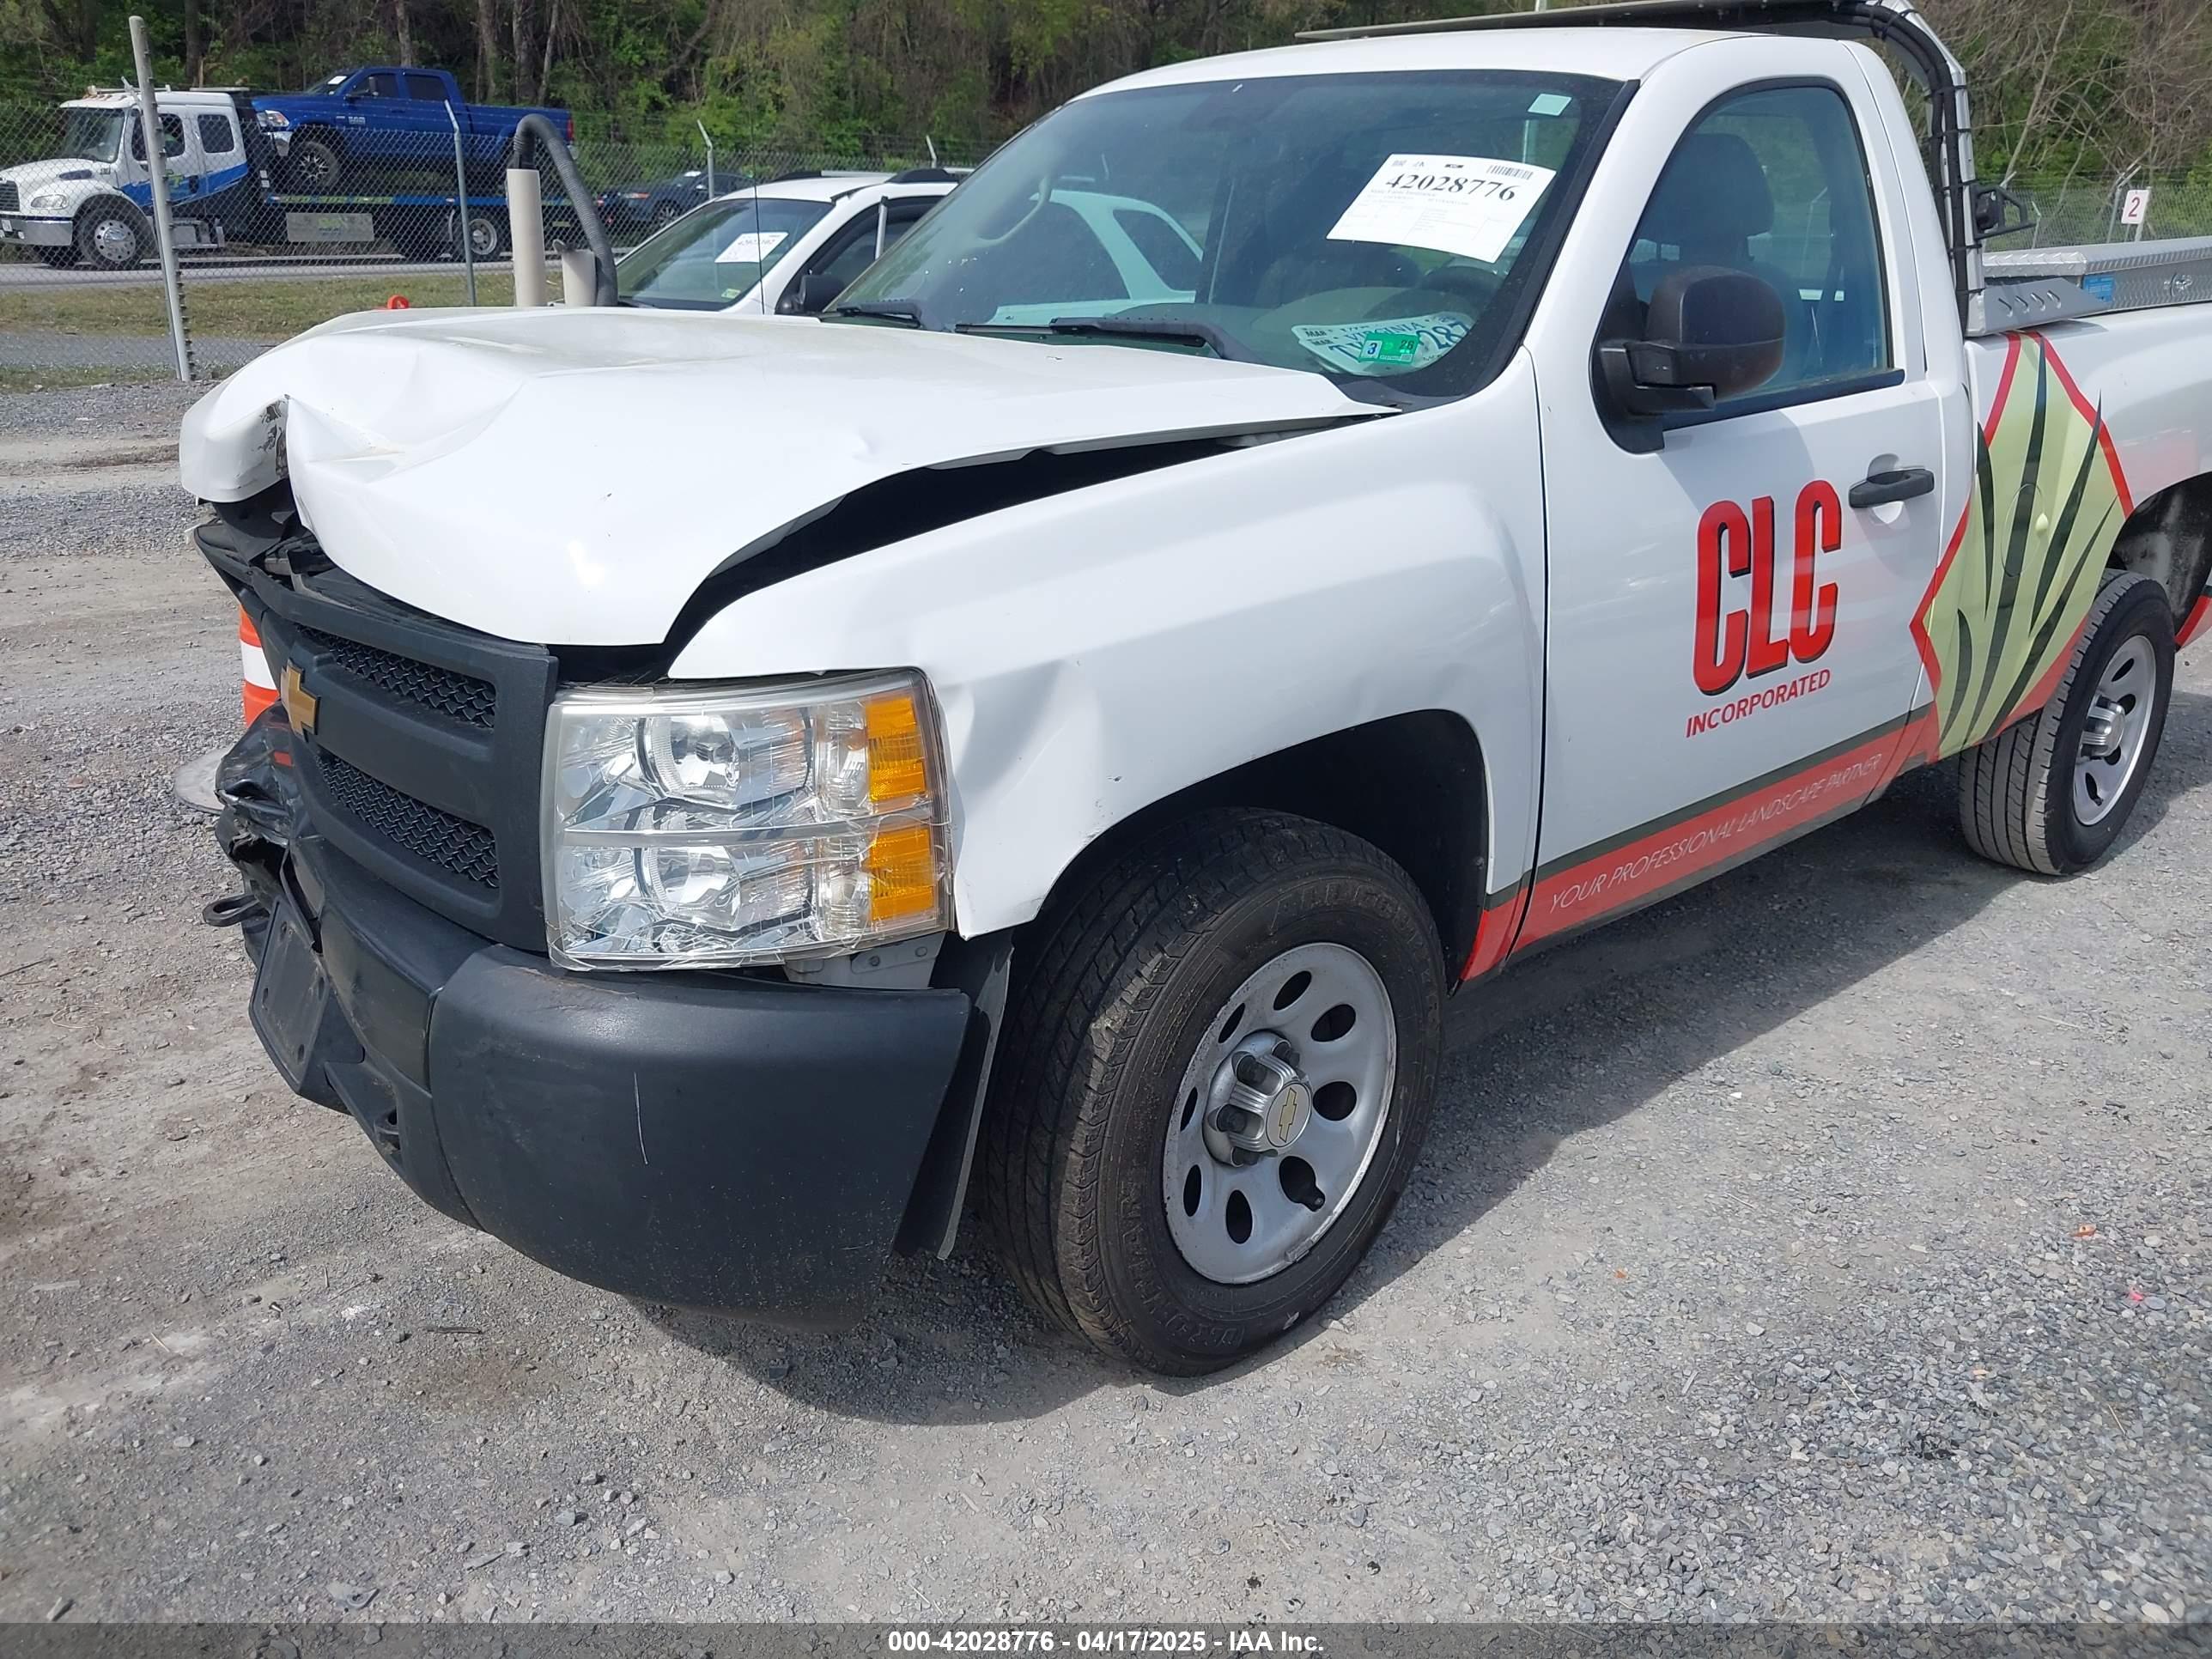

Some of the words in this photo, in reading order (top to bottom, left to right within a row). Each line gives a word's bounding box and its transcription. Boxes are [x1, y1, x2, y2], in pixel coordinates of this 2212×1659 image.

[1385, 173, 1521, 201] 42028776
[2128, 197, 2141, 217] 2
[1367, 343, 1377, 355] 3
[1400, 340, 1415, 350] 26
[1693, 479, 1842, 696] CLC
[1686, 669, 1831, 738] INCORPORATED
[1550, 873, 1607, 915] YOUR
[1607, 817, 1735, 889] PROFESSIONAL
[1736, 778, 1826, 832] LANDSCAPE
